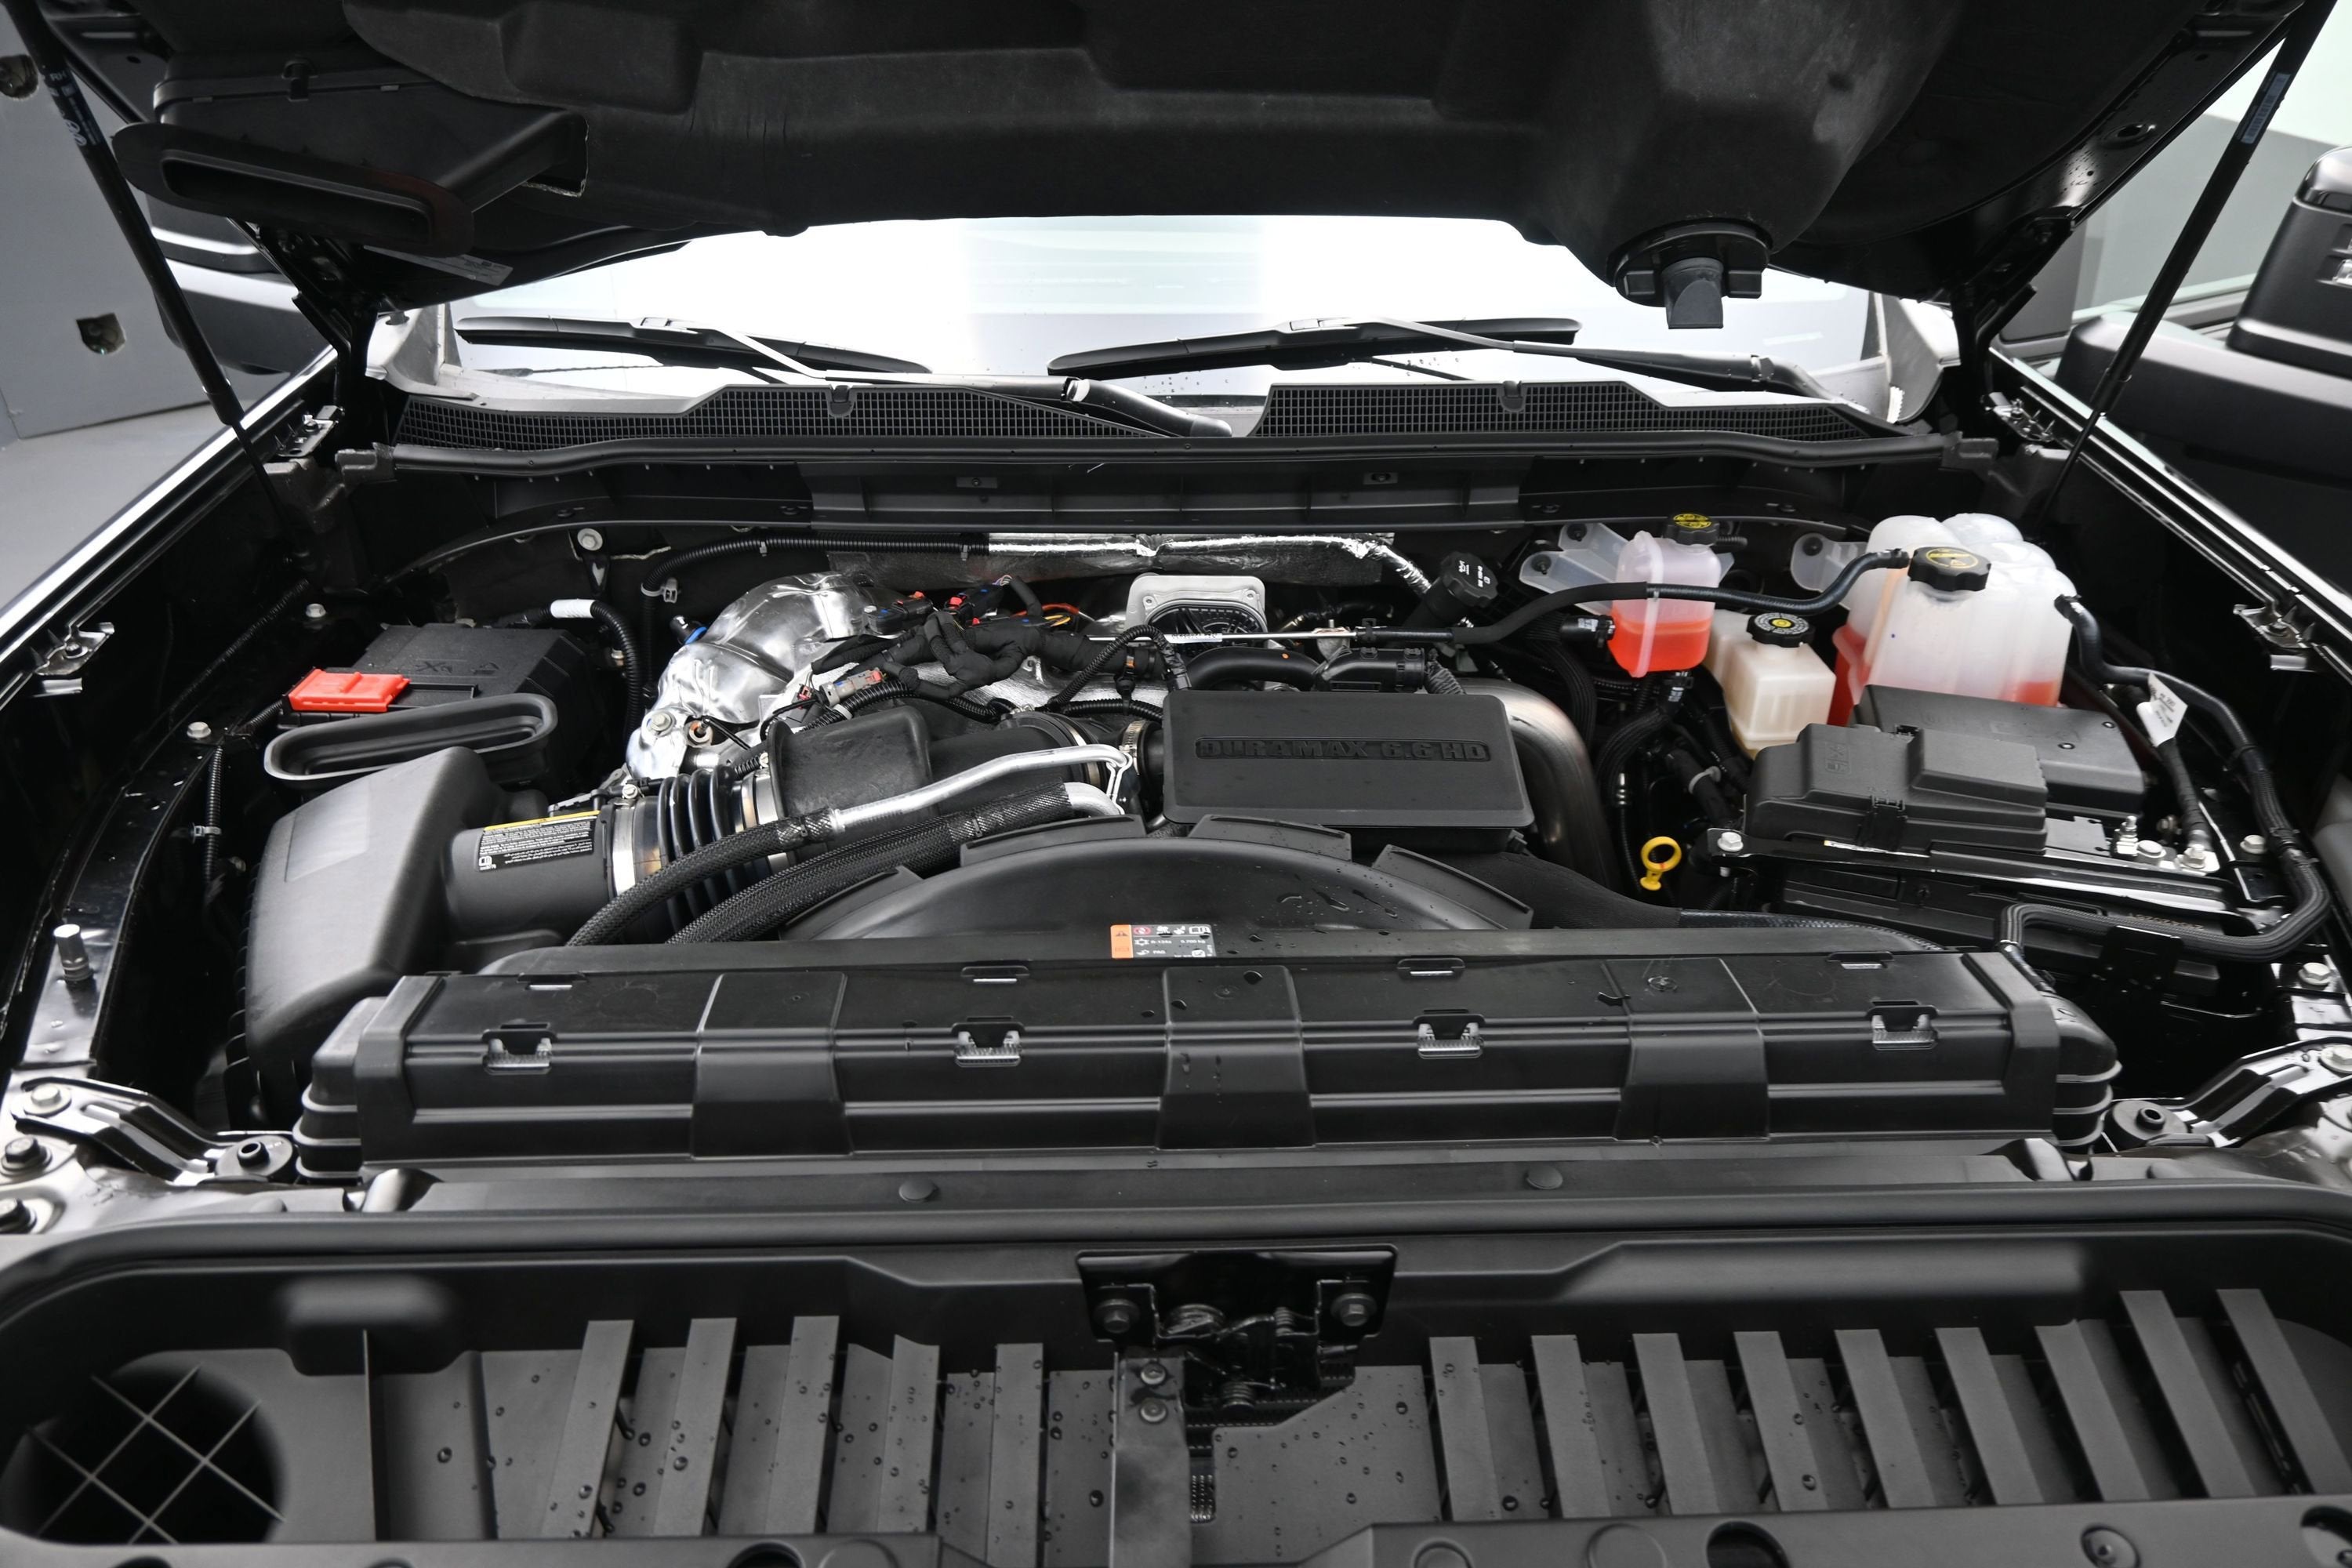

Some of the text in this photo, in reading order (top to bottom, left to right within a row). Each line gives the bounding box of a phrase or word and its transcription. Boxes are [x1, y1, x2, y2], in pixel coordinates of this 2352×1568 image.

[1199, 739, 1489, 760] DURAMAX 6.6 HD
